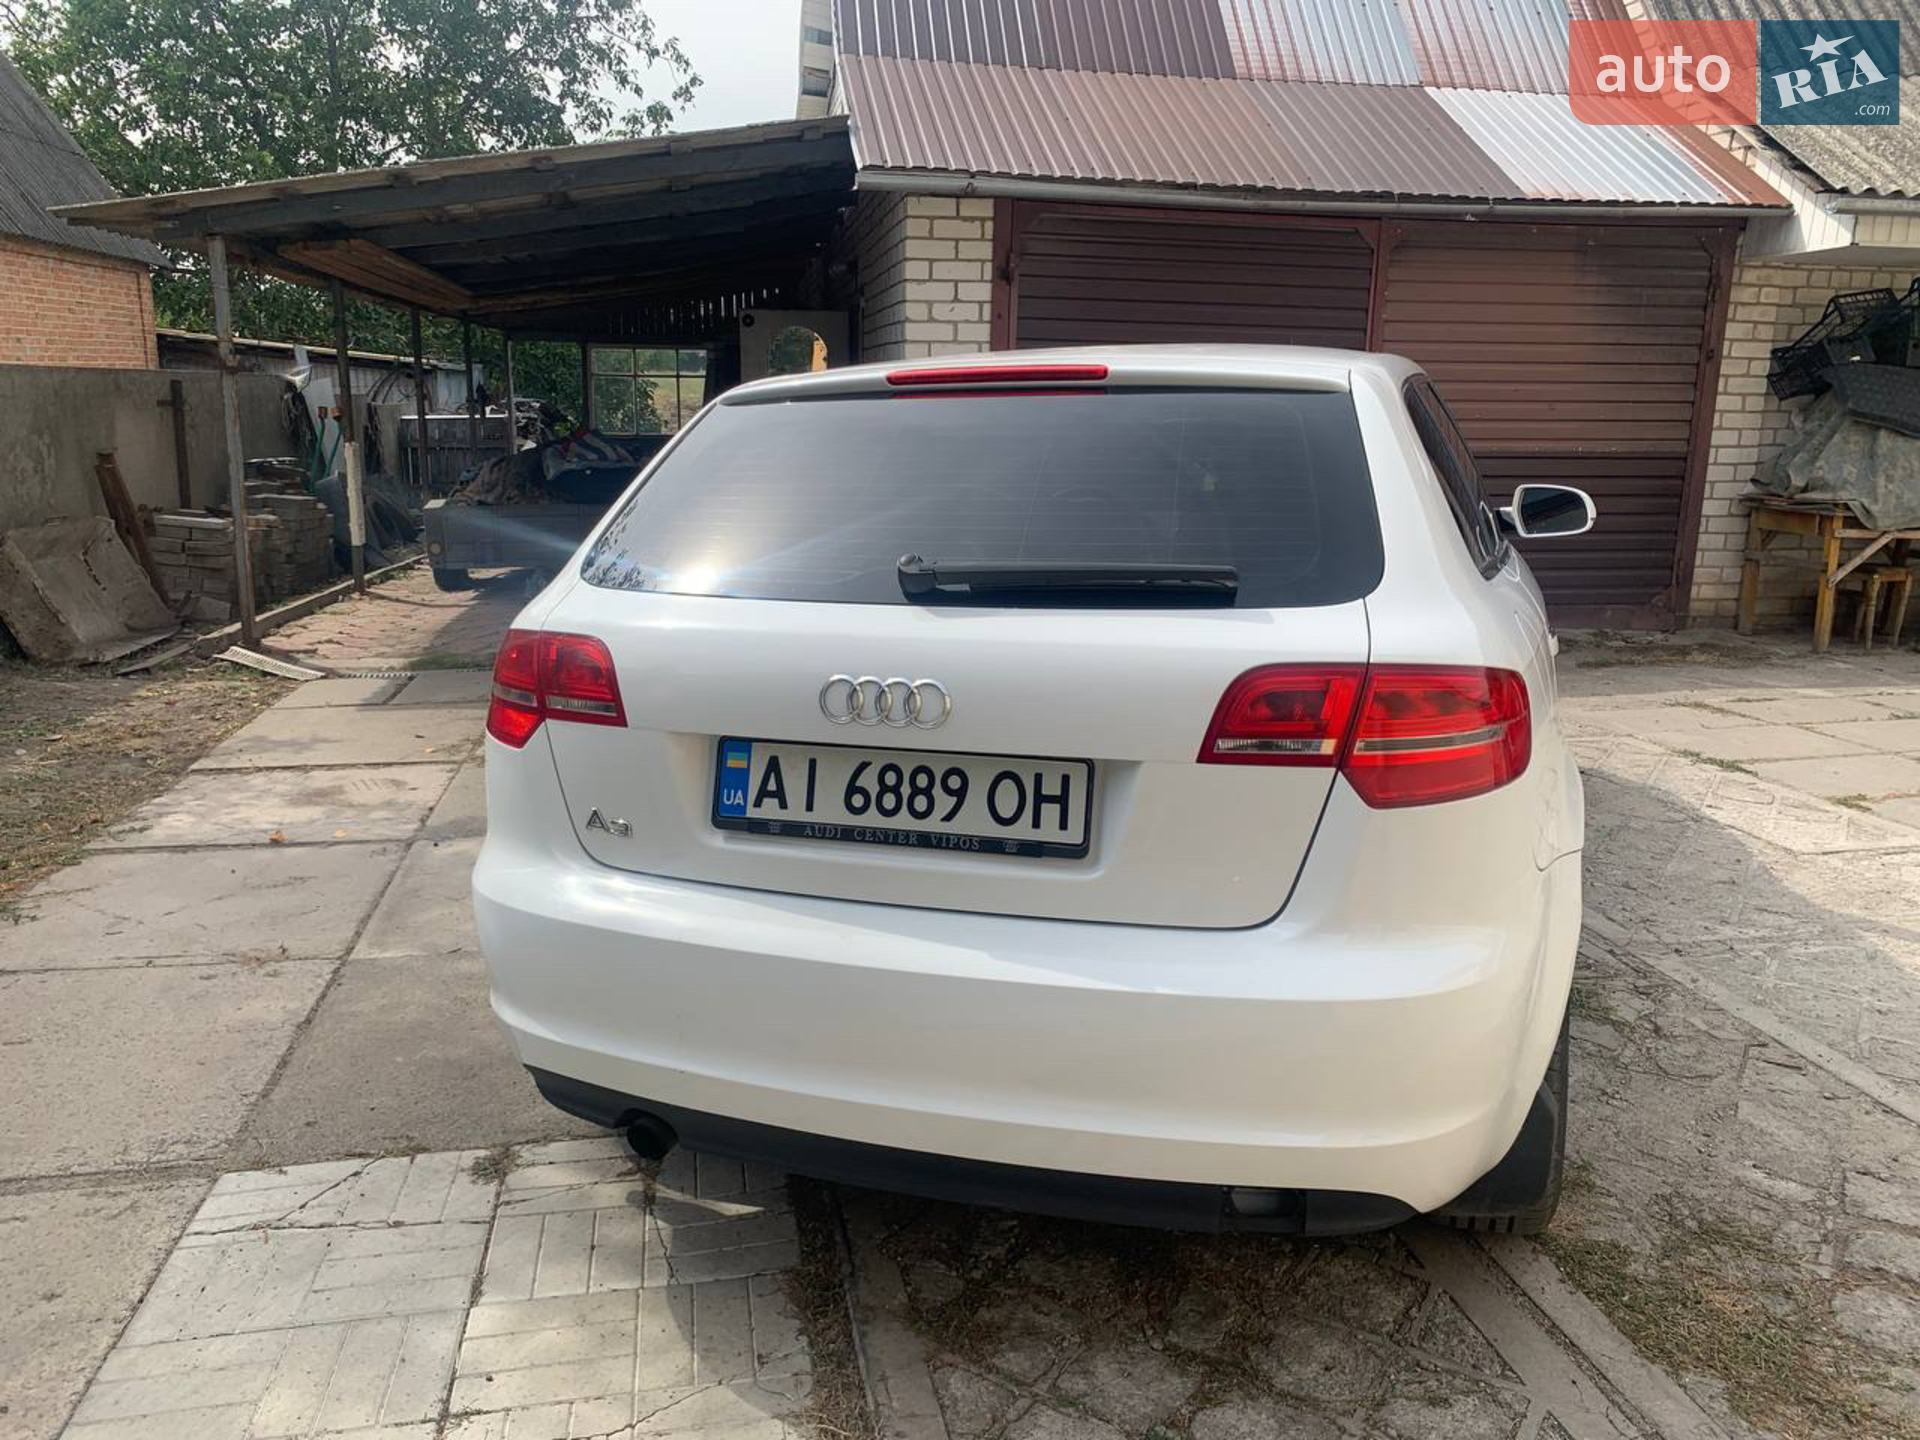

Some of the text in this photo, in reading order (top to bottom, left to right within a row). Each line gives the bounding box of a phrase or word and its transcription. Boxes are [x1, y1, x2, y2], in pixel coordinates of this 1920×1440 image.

[723, 788, 745, 806] UA
[752, 755, 1071, 831] AI 6889 OH
[586, 806, 633, 838] A3
[803, 825, 980, 850] AUDI CENTER VIPOS
